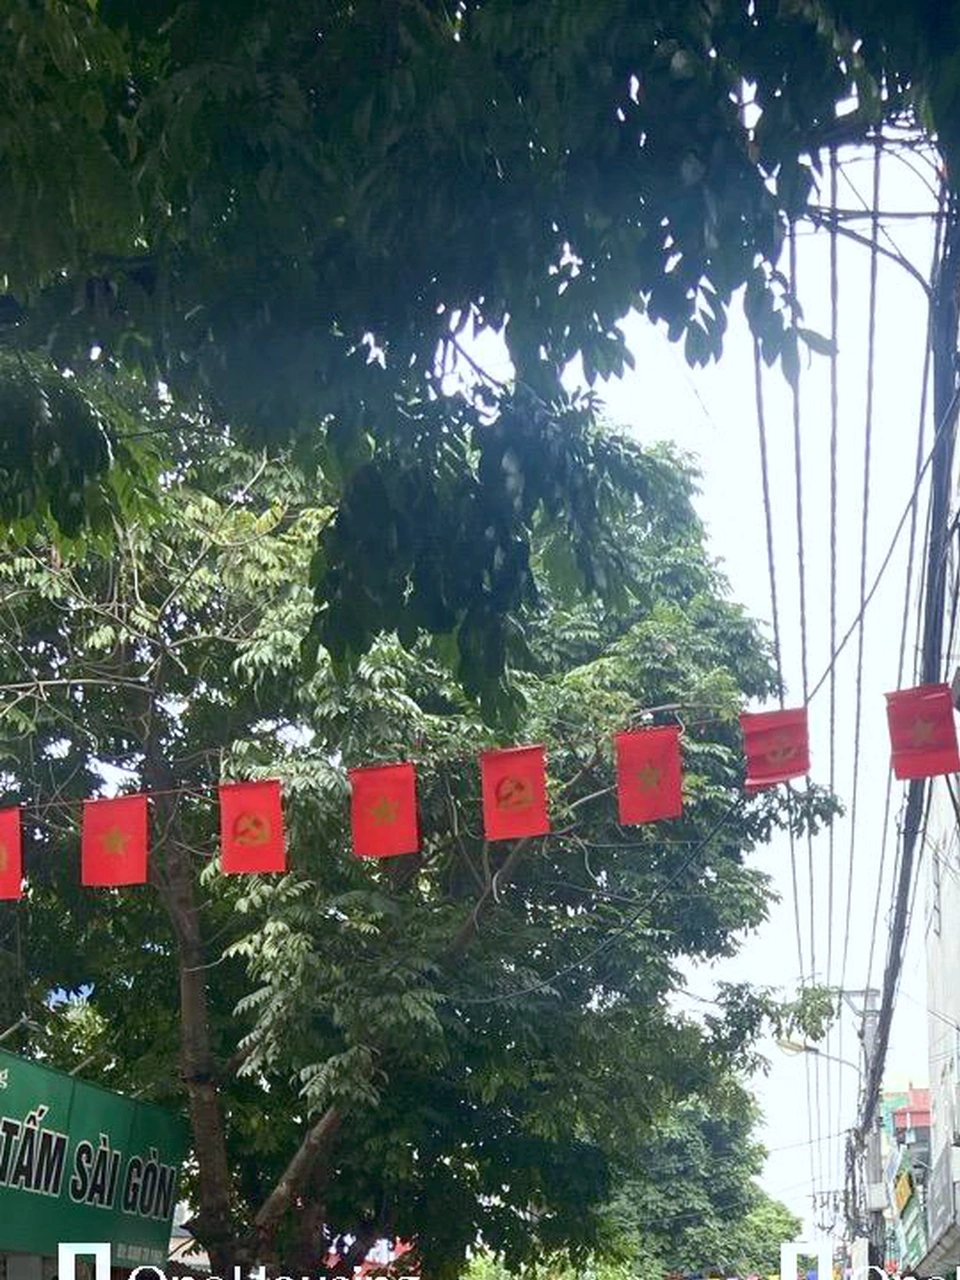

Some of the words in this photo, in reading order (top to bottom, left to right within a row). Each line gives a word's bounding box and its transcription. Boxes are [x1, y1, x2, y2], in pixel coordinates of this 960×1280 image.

[0, 1104, 70, 1198] TẤM
[69, 1133, 122, 1210] SÀI
[121, 1146, 177, 1221] GÒN
